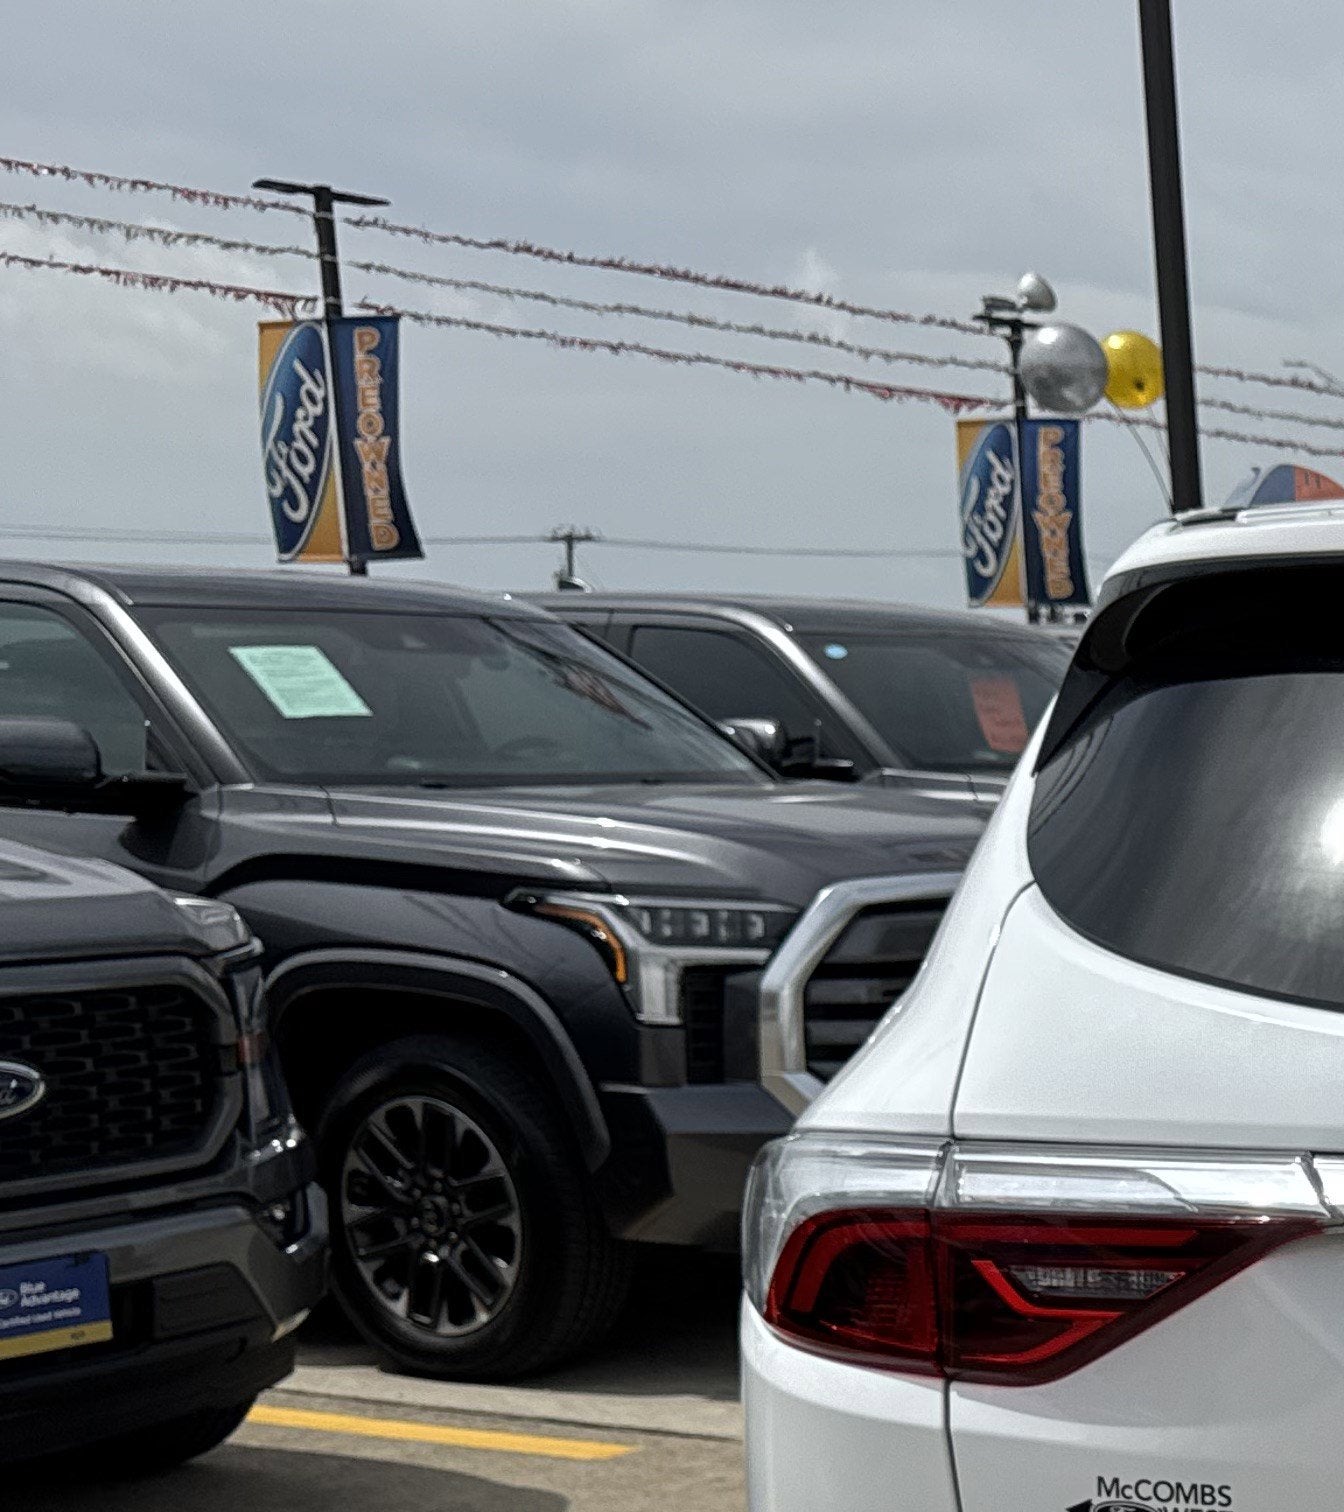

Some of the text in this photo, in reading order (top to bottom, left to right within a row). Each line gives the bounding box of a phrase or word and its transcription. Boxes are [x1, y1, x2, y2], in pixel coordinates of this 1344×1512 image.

[267, 358, 325, 523] Ford
[353, 326, 399, 551] PREOWNED
[964, 449, 1016, 577] Ford
[1097, 1476, 1232, 1507] McCOMBS
